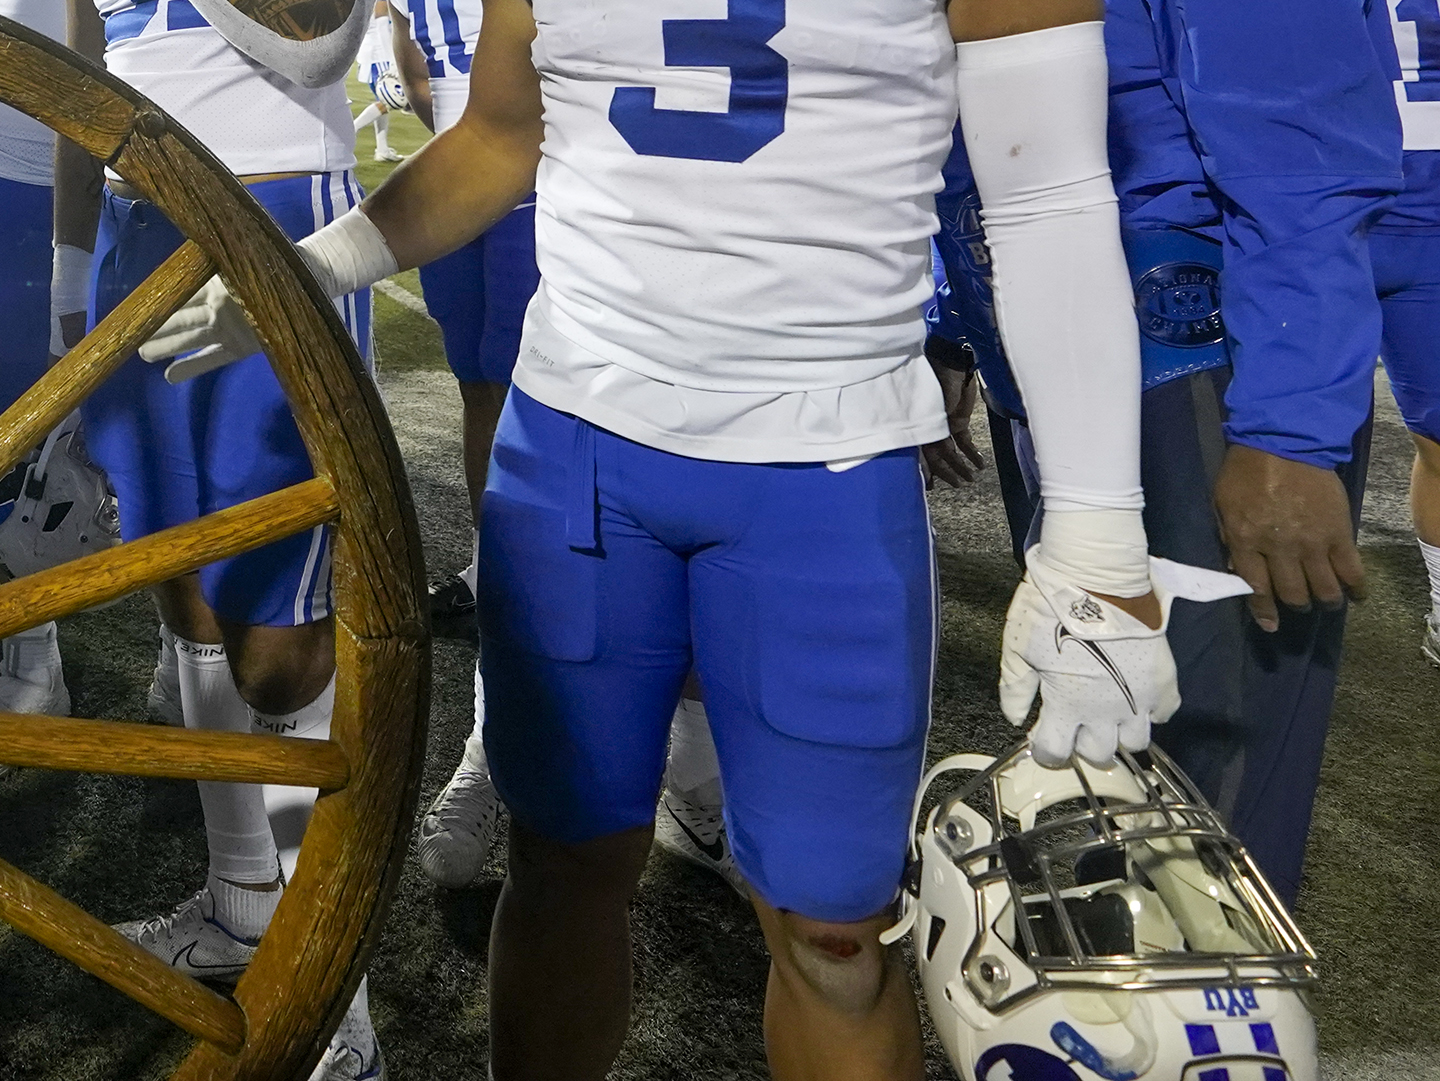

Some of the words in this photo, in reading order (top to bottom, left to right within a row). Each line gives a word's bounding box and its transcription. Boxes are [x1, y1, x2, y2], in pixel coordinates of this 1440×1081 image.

[529, 345, 555, 368] DRI-FIT
[180, 642, 225, 657] NIKE
[253, 714, 298, 734] NIKE
[1203, 986, 1260, 1017] BYU
